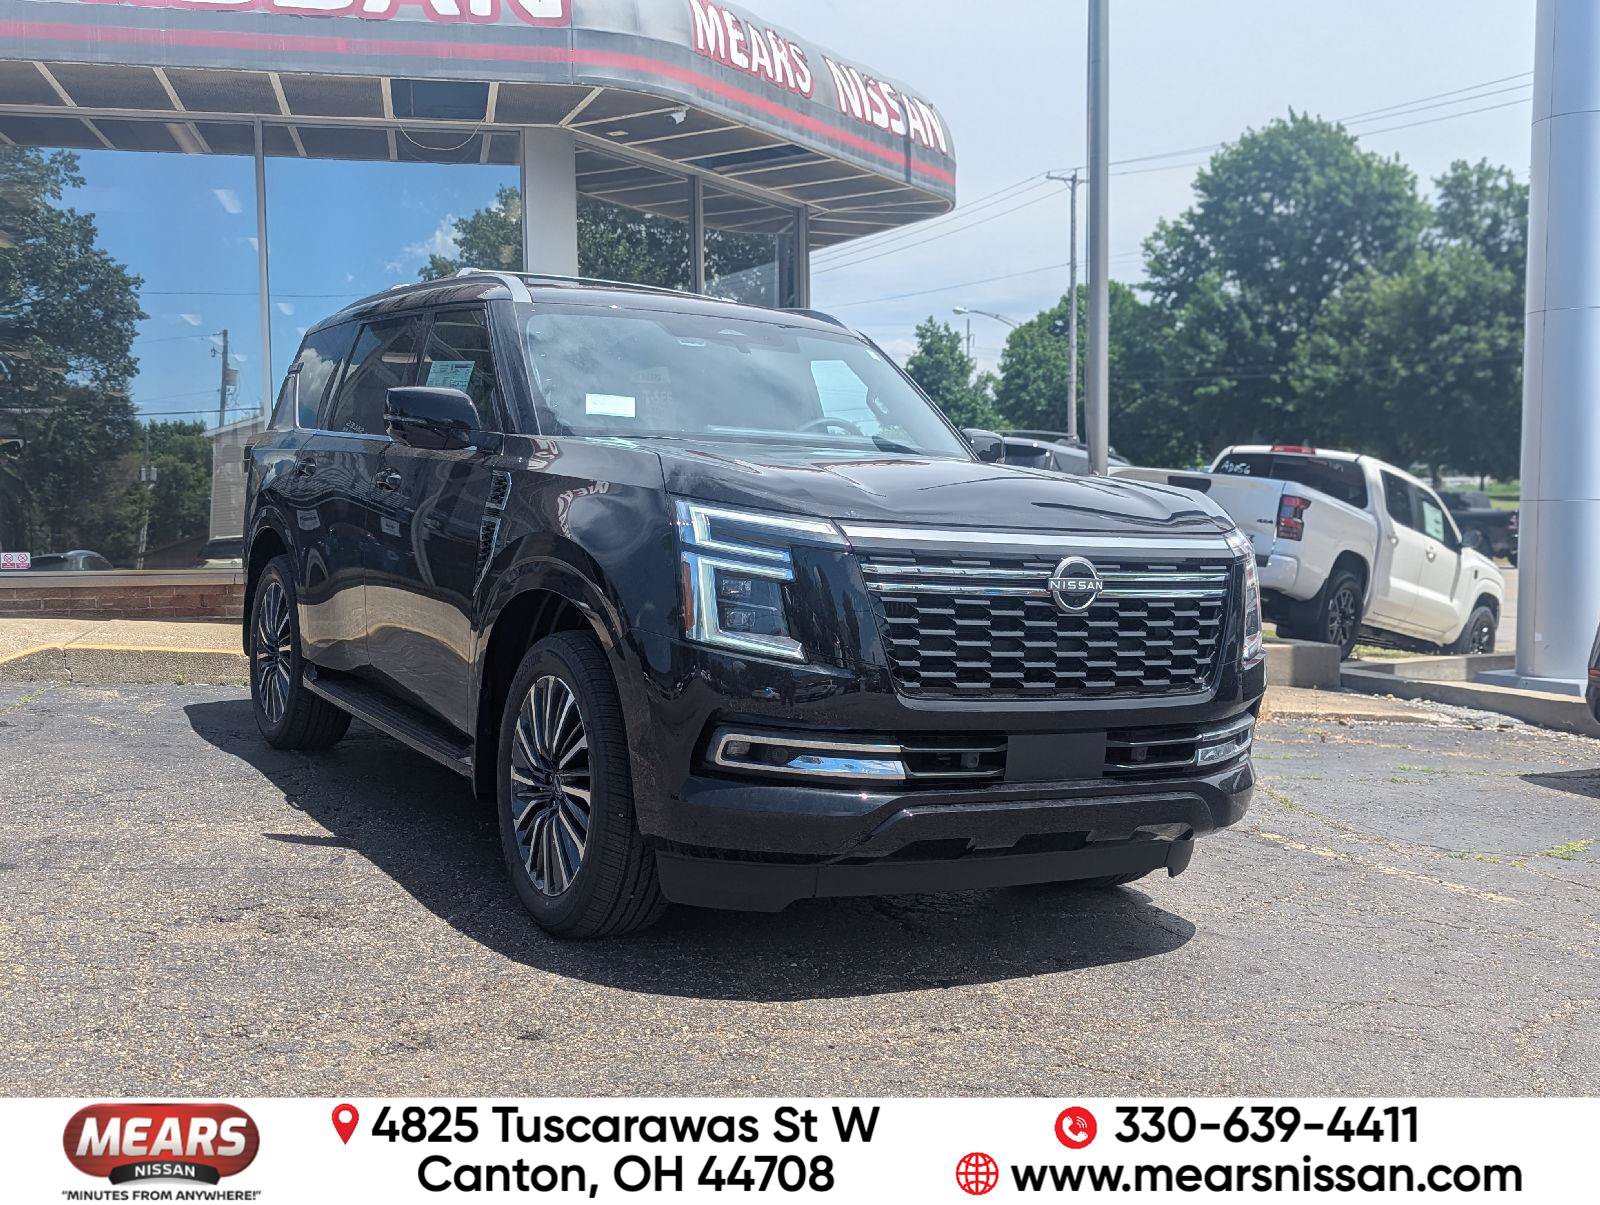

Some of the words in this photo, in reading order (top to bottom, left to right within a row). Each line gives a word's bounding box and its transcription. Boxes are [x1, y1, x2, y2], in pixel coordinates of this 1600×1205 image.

[690, 0, 813, 97] MEARS
[823, 55, 947, 153] NISSAN
[1050, 580, 1103, 590] NISSAN
